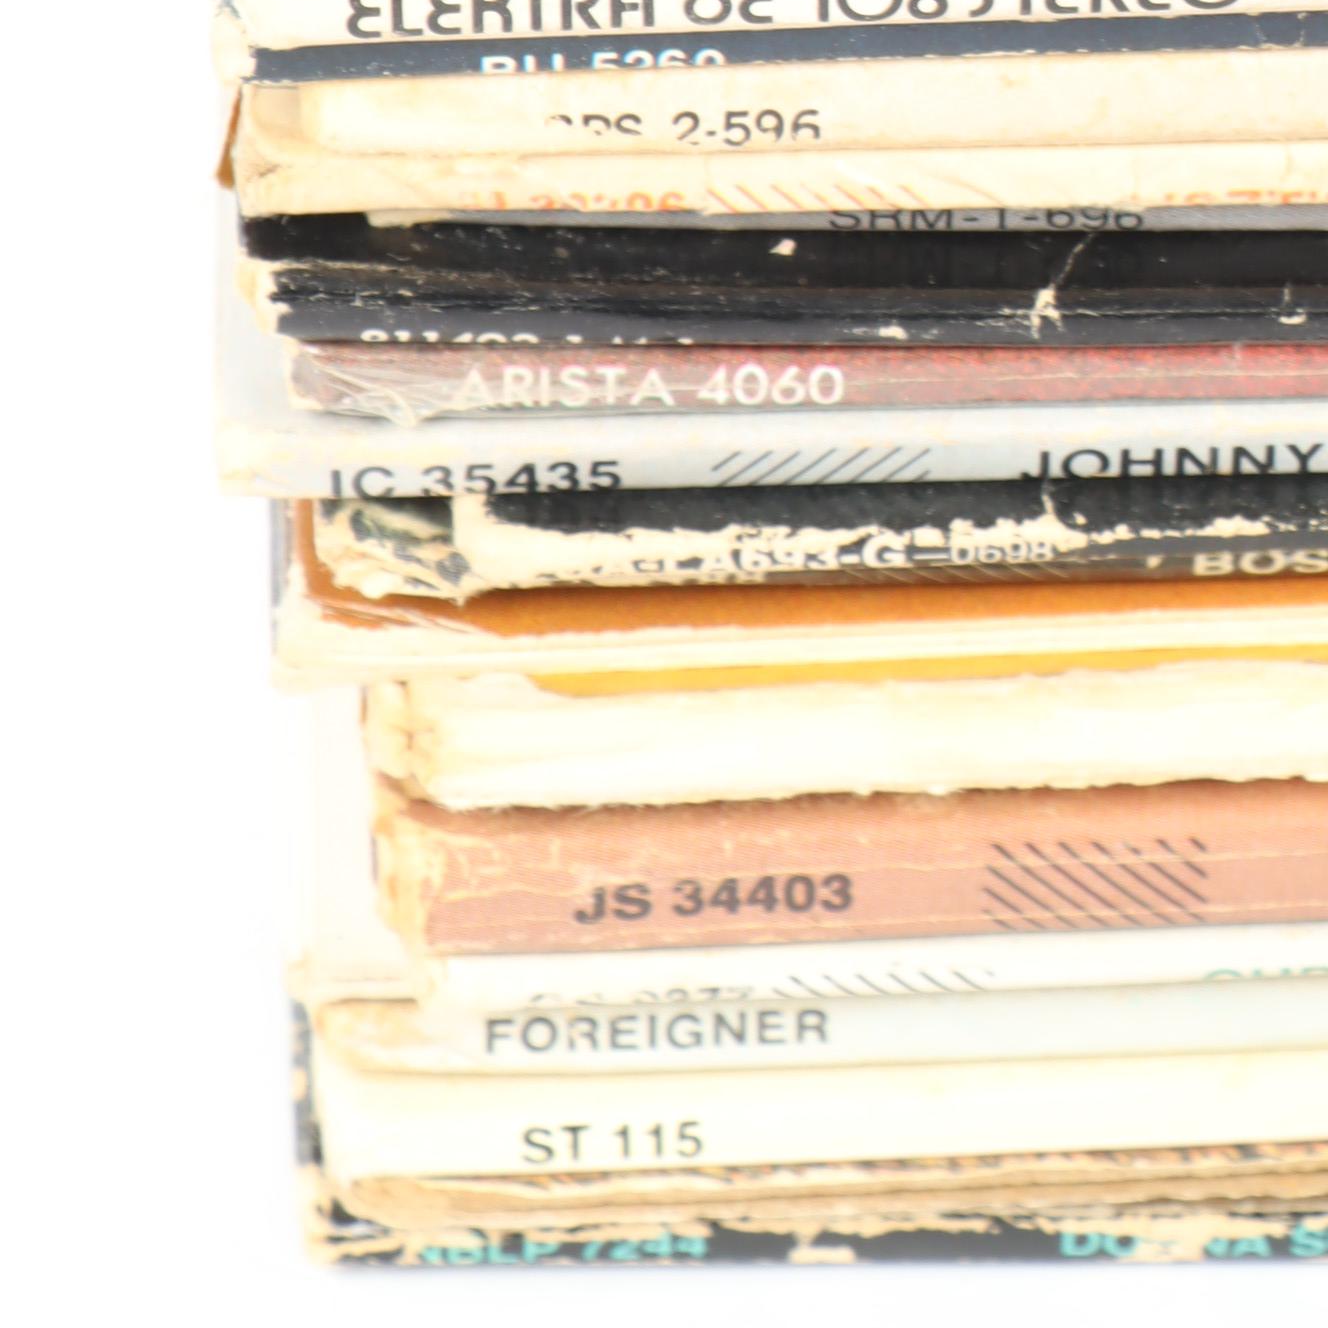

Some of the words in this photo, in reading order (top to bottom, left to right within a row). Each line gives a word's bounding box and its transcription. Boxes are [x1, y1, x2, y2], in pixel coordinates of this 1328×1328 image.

[450, 363, 677, 407] ARISTA
[696, 362, 846, 407] 4060
[1018, 442, 1326, 482] JOHNNY
[573, 878, 652, 927] JS
[671, 871, 856, 919] 34403
[483, 1008, 831, 1055] FOREIGNER
[520, 1123, 590, 1165] ST
[612, 1119, 704, 1160] 115
[1058, 1230, 1272, 1259] DONA
